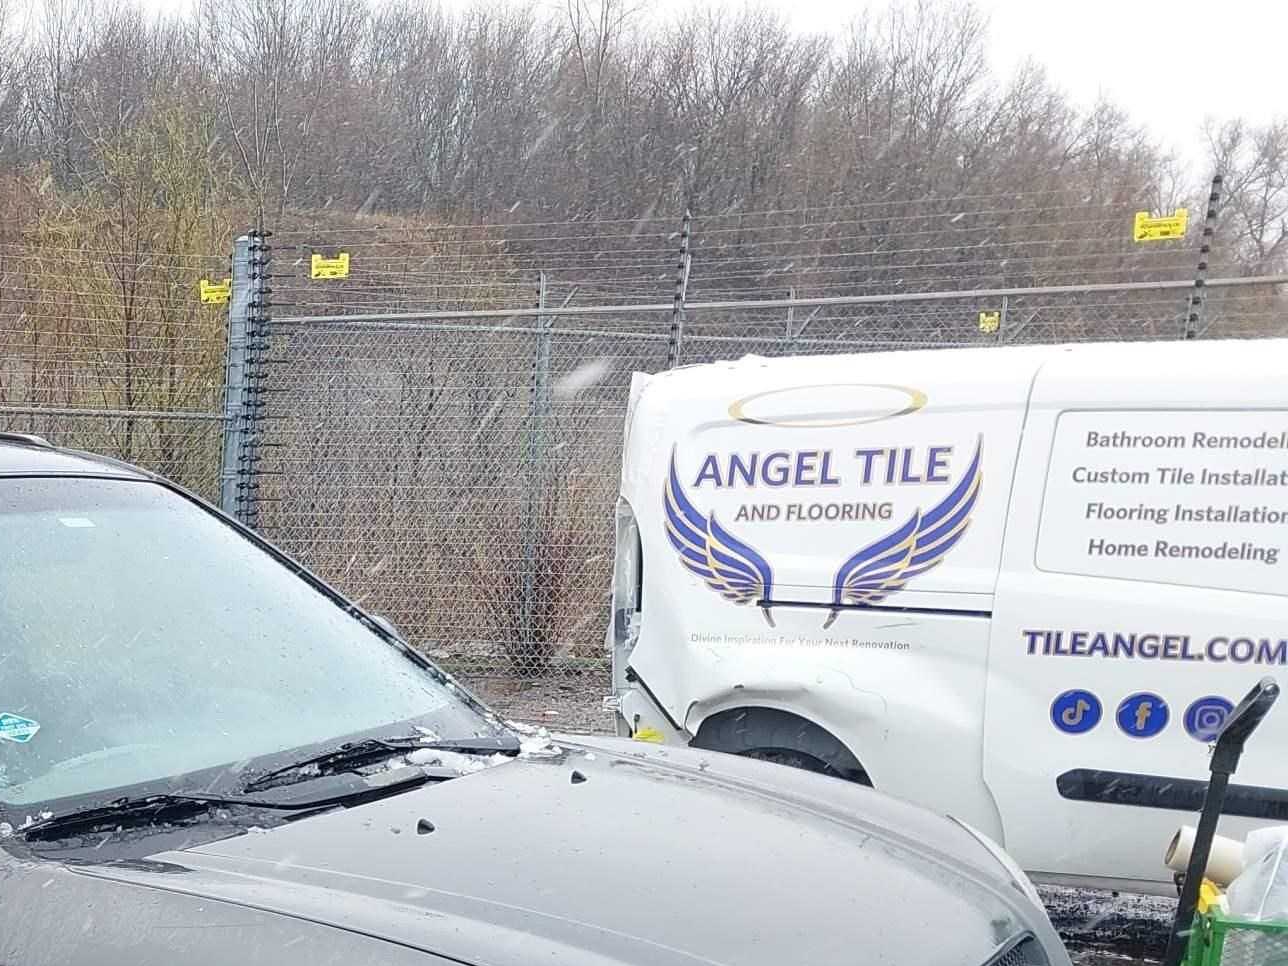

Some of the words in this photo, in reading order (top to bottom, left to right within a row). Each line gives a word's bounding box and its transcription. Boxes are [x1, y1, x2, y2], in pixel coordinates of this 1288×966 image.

[1086, 431, 1186, 448] Bathroom
[1192, 431, 1288, 449] Remodel
[692, 450, 840, 488] ANGEL
[855, 447, 952, 484] TILE
[1072, 466, 1150, 484] Custom
[1157, 467, 1194, 485] Tile
[734, 504, 781, 522] AND
[786, 502, 893, 521] FLOORING
[1085, 502, 1168, 524] Flooring
[1087, 538, 1149, 557] Home
[1154, 540, 1280, 565] Remodeling
[690, 633, 722, 643] Divine
[779, 636, 796, 646] For
[798, 637, 823, 648] Your
[824, 638, 849, 648] Next
[851, 638, 910, 650] Renovation
[1022, 629, 1288, 665] TILEANGEL.COM
